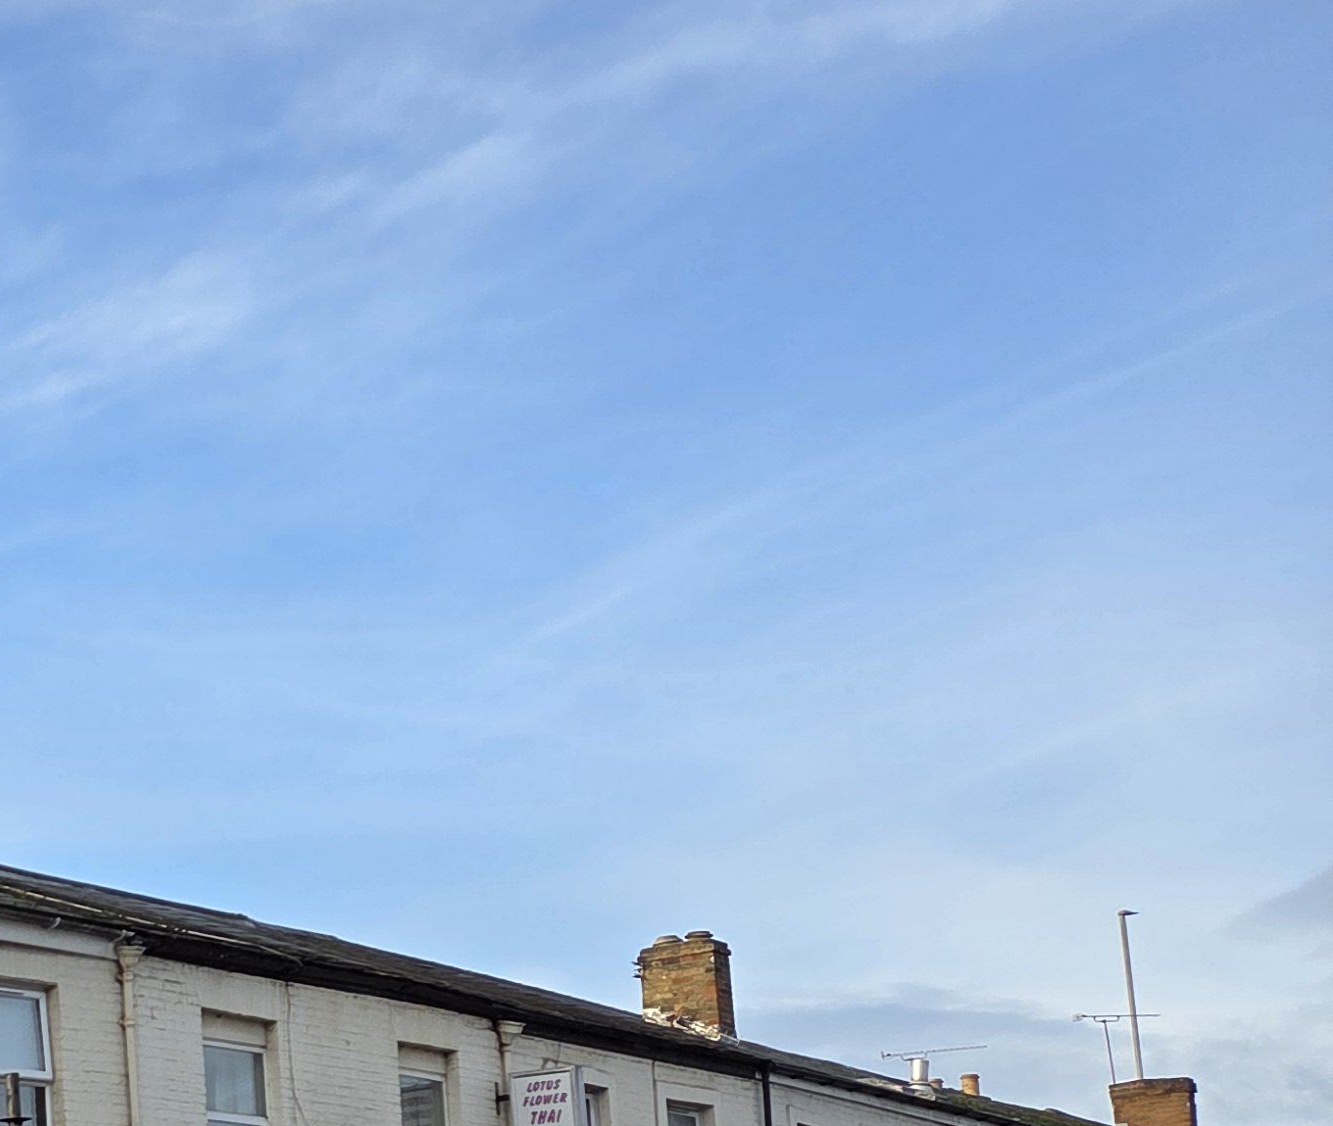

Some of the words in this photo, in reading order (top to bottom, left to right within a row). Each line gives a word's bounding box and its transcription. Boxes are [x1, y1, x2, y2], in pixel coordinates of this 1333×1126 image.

[526, 1079, 561, 1093] LOTUS
[523, 1092, 568, 1107] FLOWER
[531, 1109, 562, 1125] THAI
